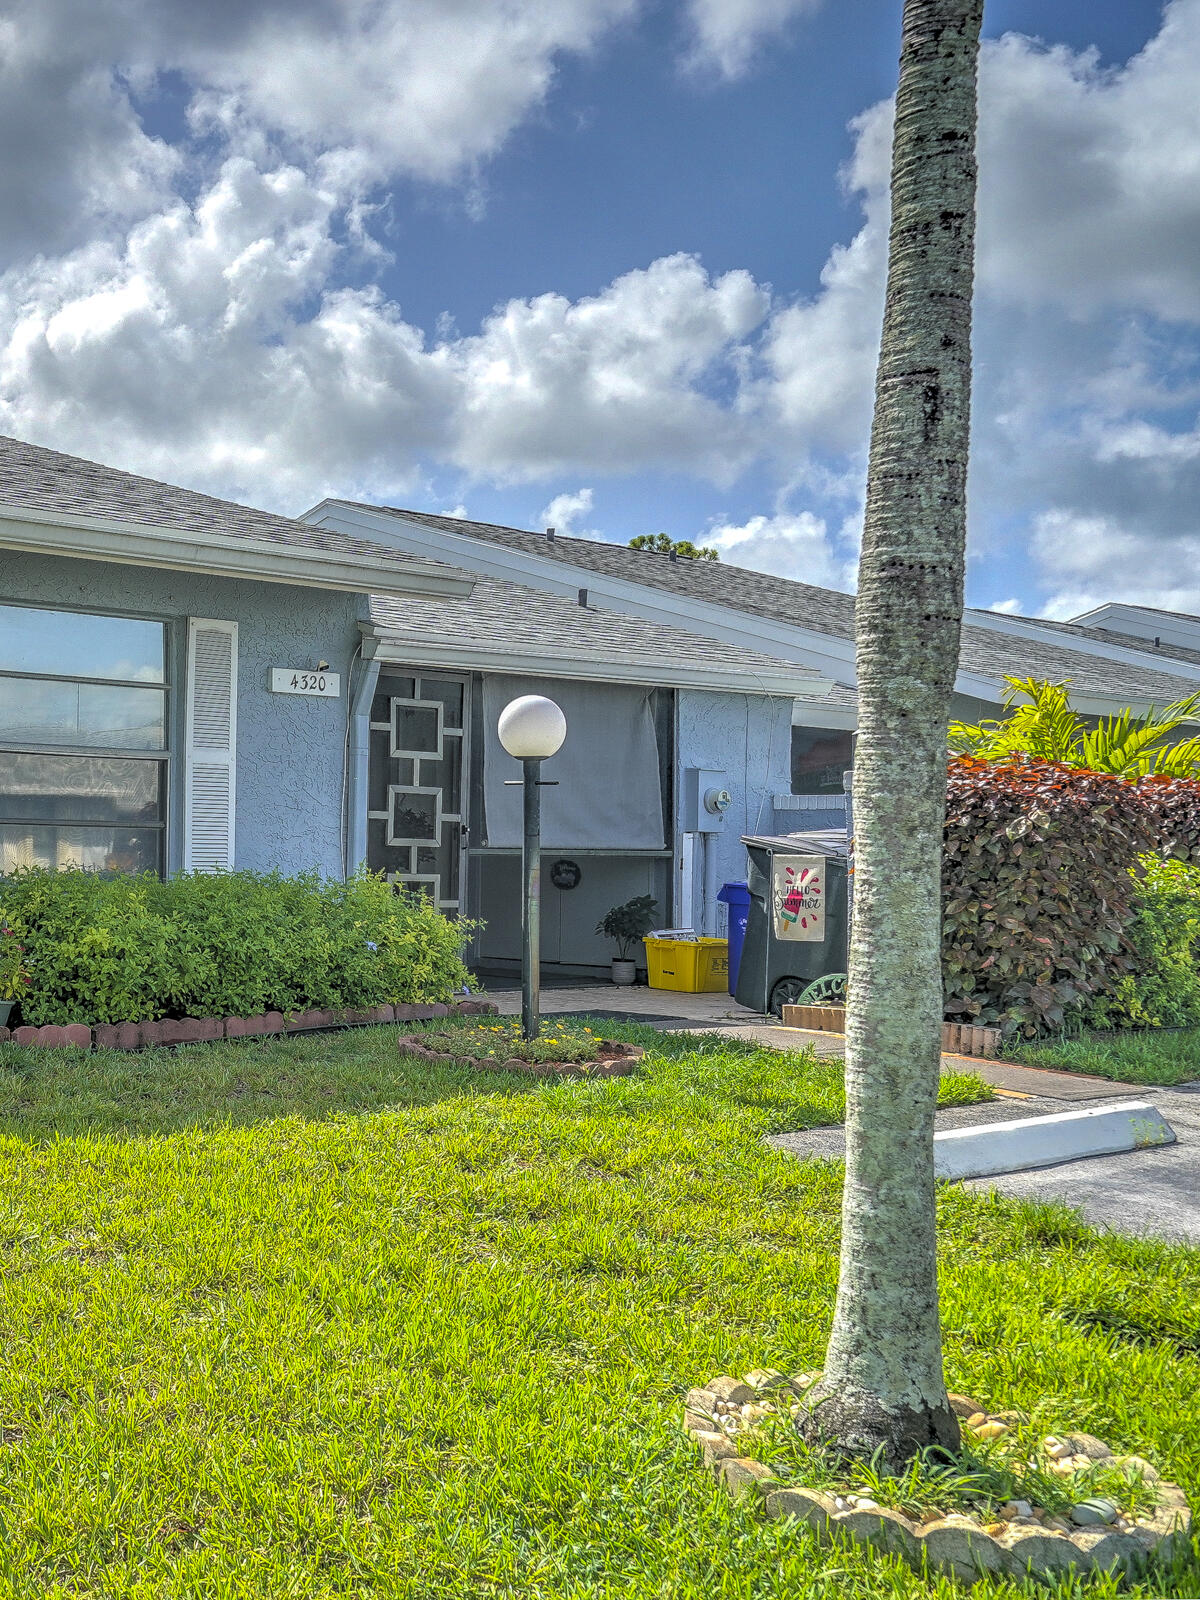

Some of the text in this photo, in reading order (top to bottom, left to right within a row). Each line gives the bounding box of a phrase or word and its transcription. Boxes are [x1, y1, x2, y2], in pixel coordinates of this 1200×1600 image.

[290, 674, 326, 691] 4320
[786, 885, 810, 895] HELLO
[774, 890, 821, 911] Summer
